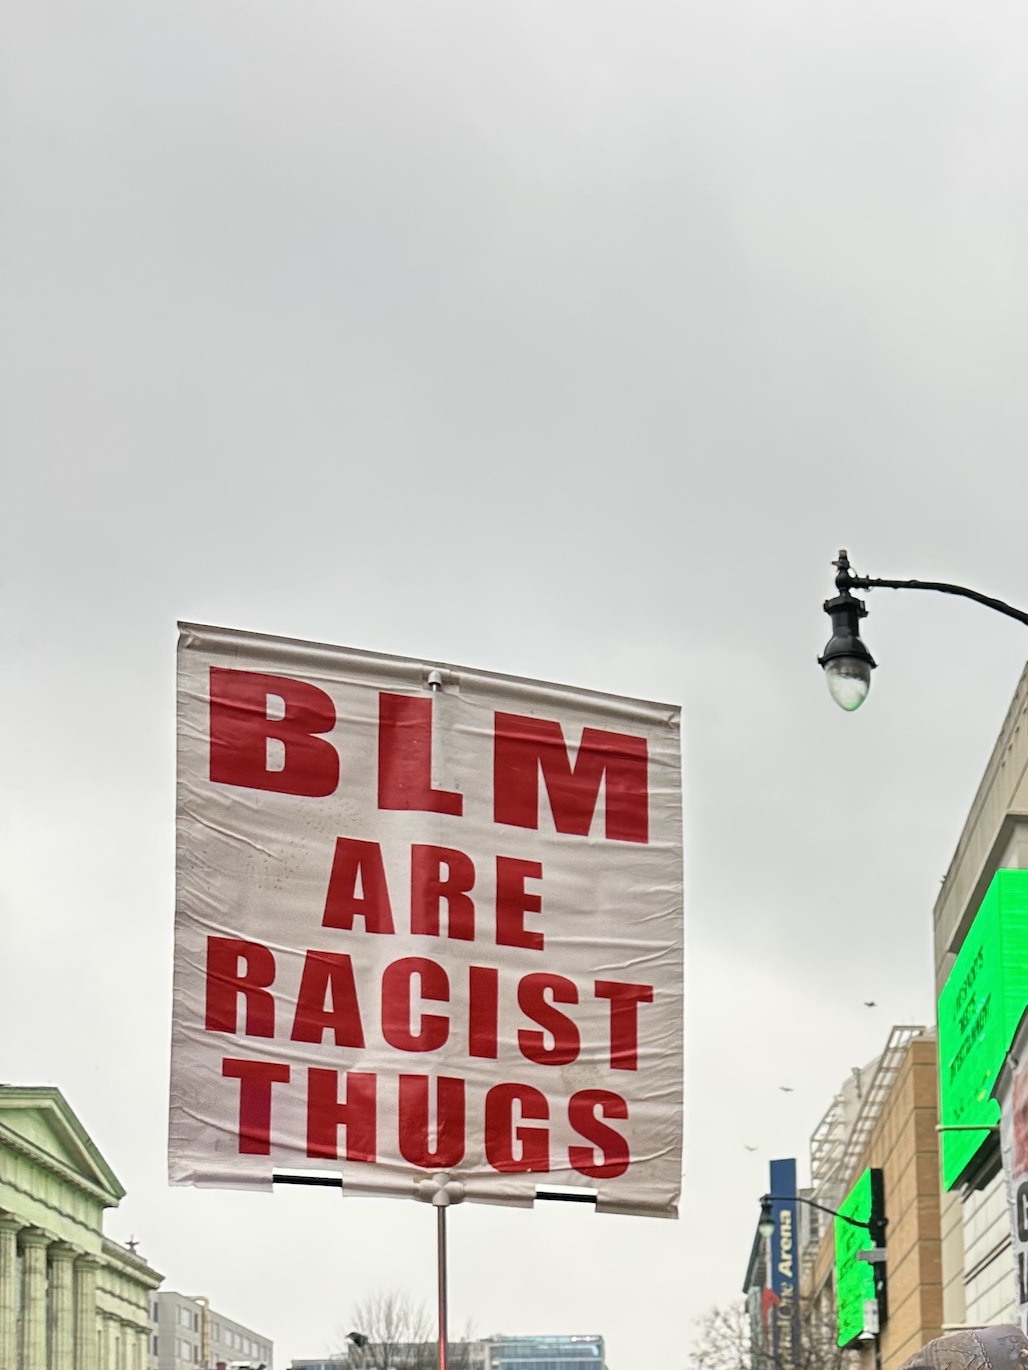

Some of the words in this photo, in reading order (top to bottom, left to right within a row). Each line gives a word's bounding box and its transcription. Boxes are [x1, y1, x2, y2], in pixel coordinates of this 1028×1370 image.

[209, 666, 648, 844] BLM
[321, 836, 545, 951] ARE
[204, 935, 653, 1071] RACIST
[222, 1057, 630, 1178] THUGS
[777, 1209, 793, 1278] Arena
